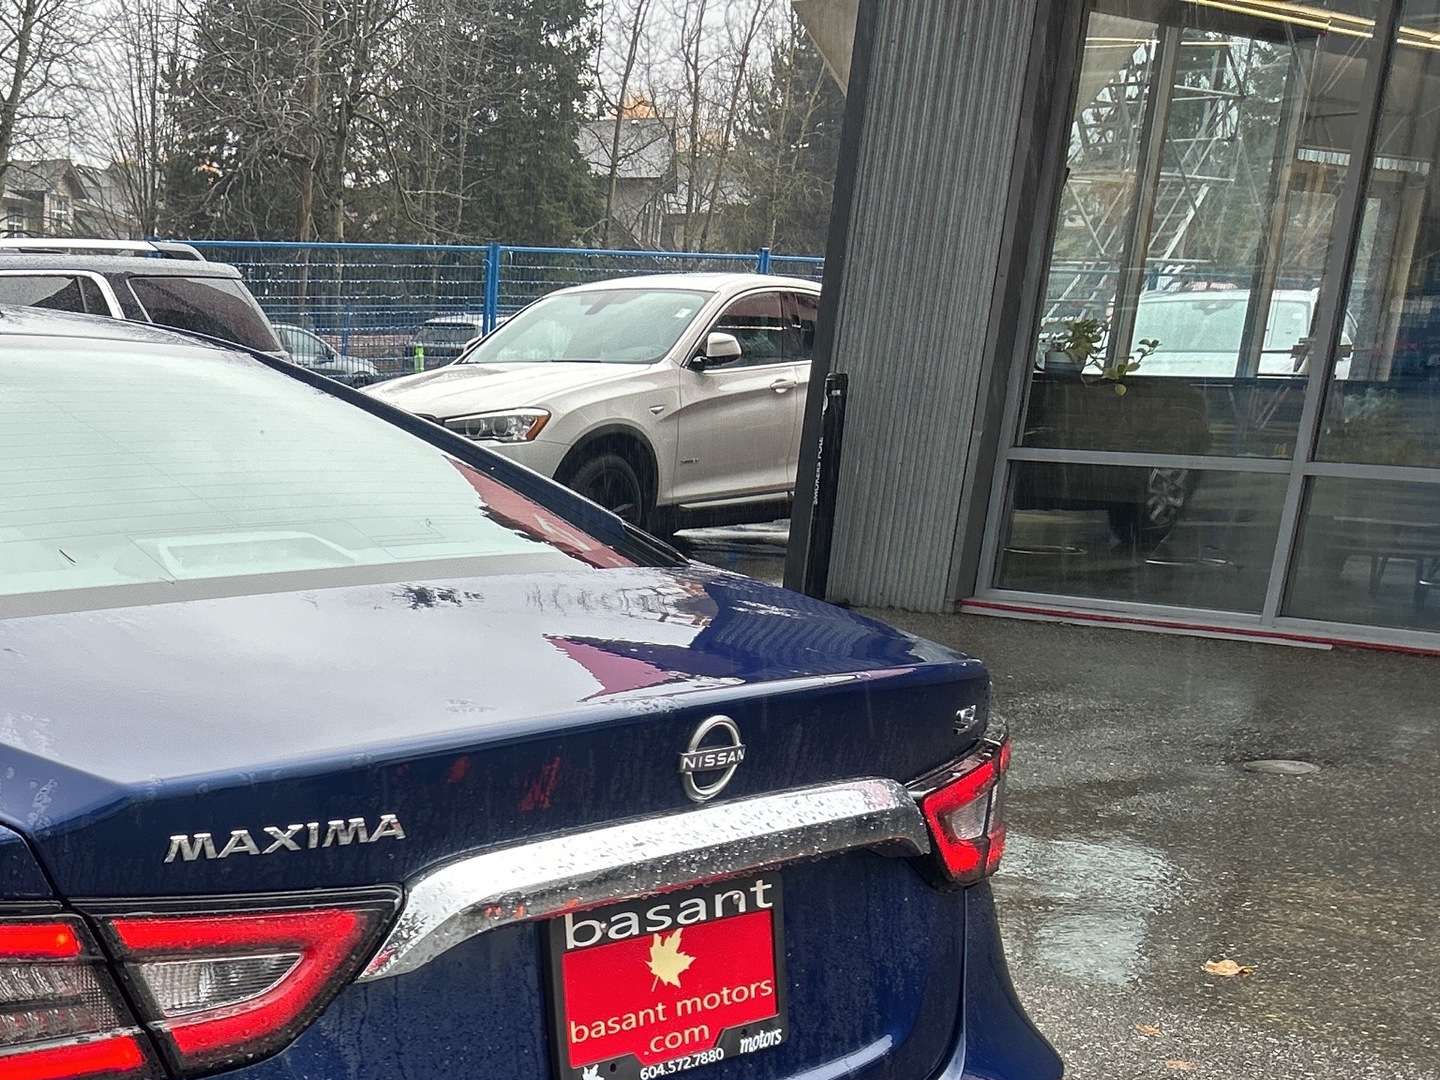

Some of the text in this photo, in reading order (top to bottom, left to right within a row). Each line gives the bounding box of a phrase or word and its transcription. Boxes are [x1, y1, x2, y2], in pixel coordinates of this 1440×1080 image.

[682, 748, 746, 770] NISSAN
[164, 814, 407, 863] MAXIMA
[564, 879, 774, 950] basant
[570, 978, 774, 1044] basant motors
[643, 1024, 710, 1056] .com
[739, 1028, 782, 1055] motors
[639, 1047, 725, 1080] 604.572.7880
